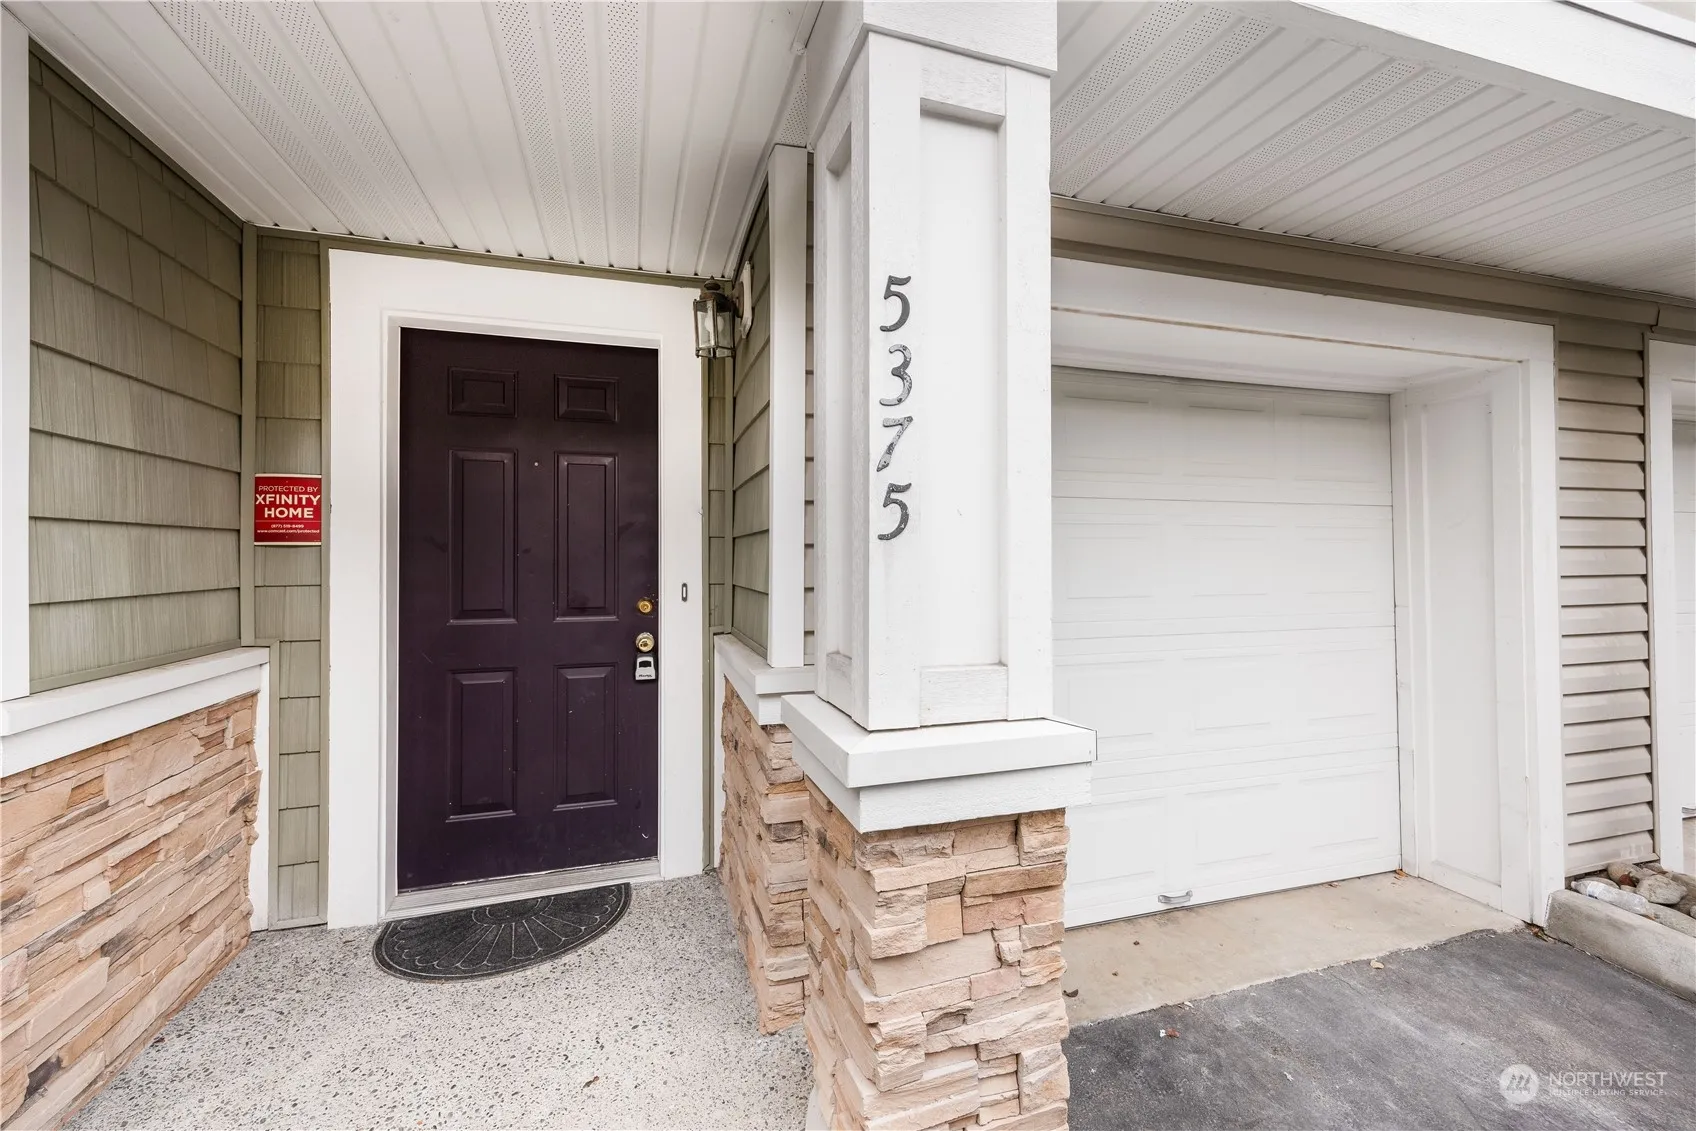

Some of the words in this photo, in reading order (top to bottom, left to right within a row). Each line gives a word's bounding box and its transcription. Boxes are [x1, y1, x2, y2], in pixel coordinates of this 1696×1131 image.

[877, 274, 914, 541] 5375
[255, 494, 321, 505] XFINITY
[264, 507, 314, 518] HOME
